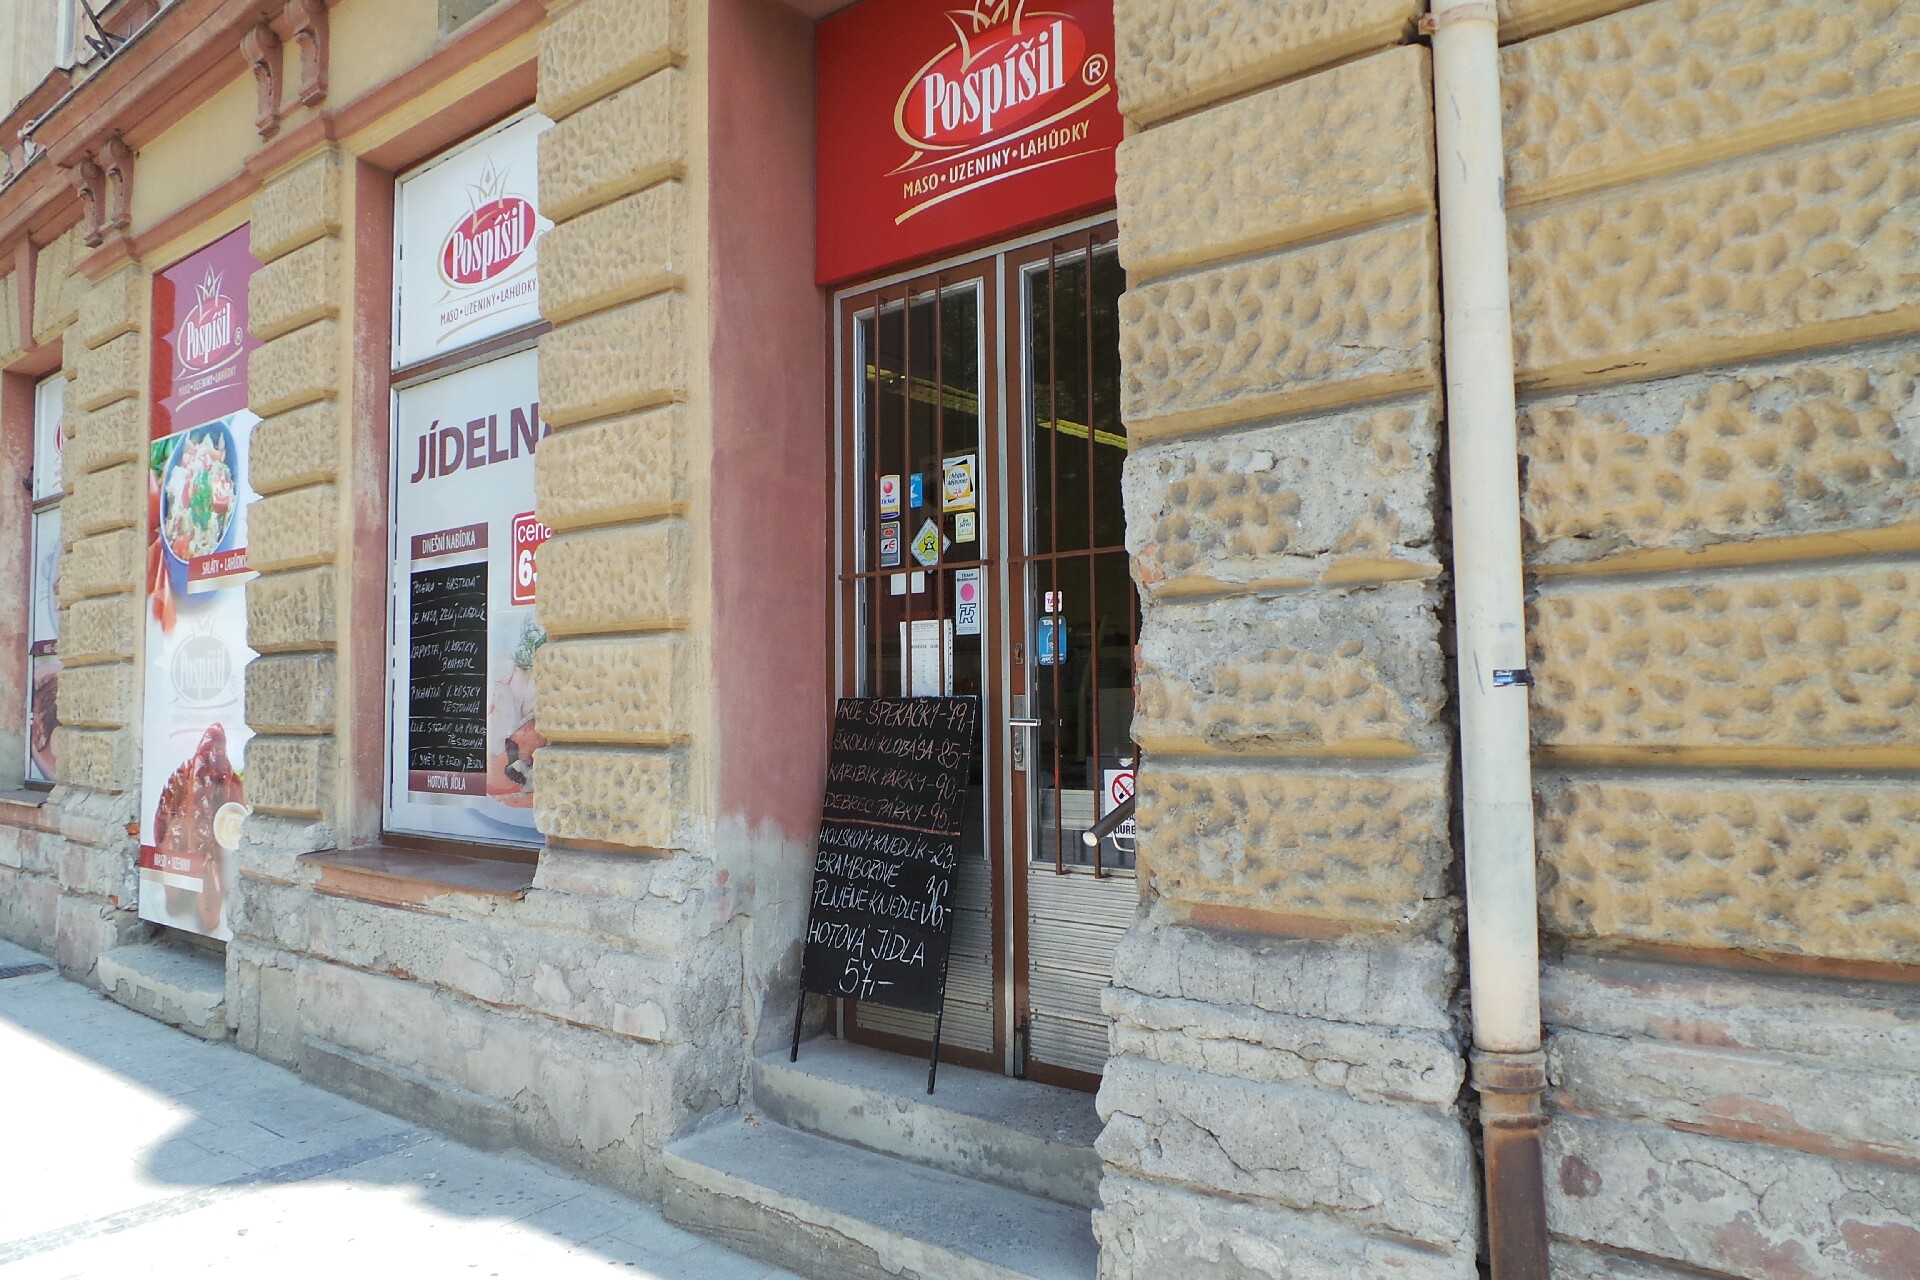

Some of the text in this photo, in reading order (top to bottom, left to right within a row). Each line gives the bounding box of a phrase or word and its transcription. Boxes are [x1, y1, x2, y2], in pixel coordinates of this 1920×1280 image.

[923, 20, 1065, 139] Pospíšil
[903, 119, 1090, 199] MASO UZENINY LAHŮDKY
[452, 200, 525, 280] Pospíšil
[186, 302, 231, 364] Pospíšil
[440, 308, 459, 326] MASO
[464, 292, 496, 316] UZENINY
[411, 402, 552, 484] JÍDELN
[422, 530, 475, 554] DNEŠNÍ NABÍDKA
[427, 774, 466, 790] HOTOVÁ JÍDLA
[808, 918, 870, 958] HOTOVÁ
